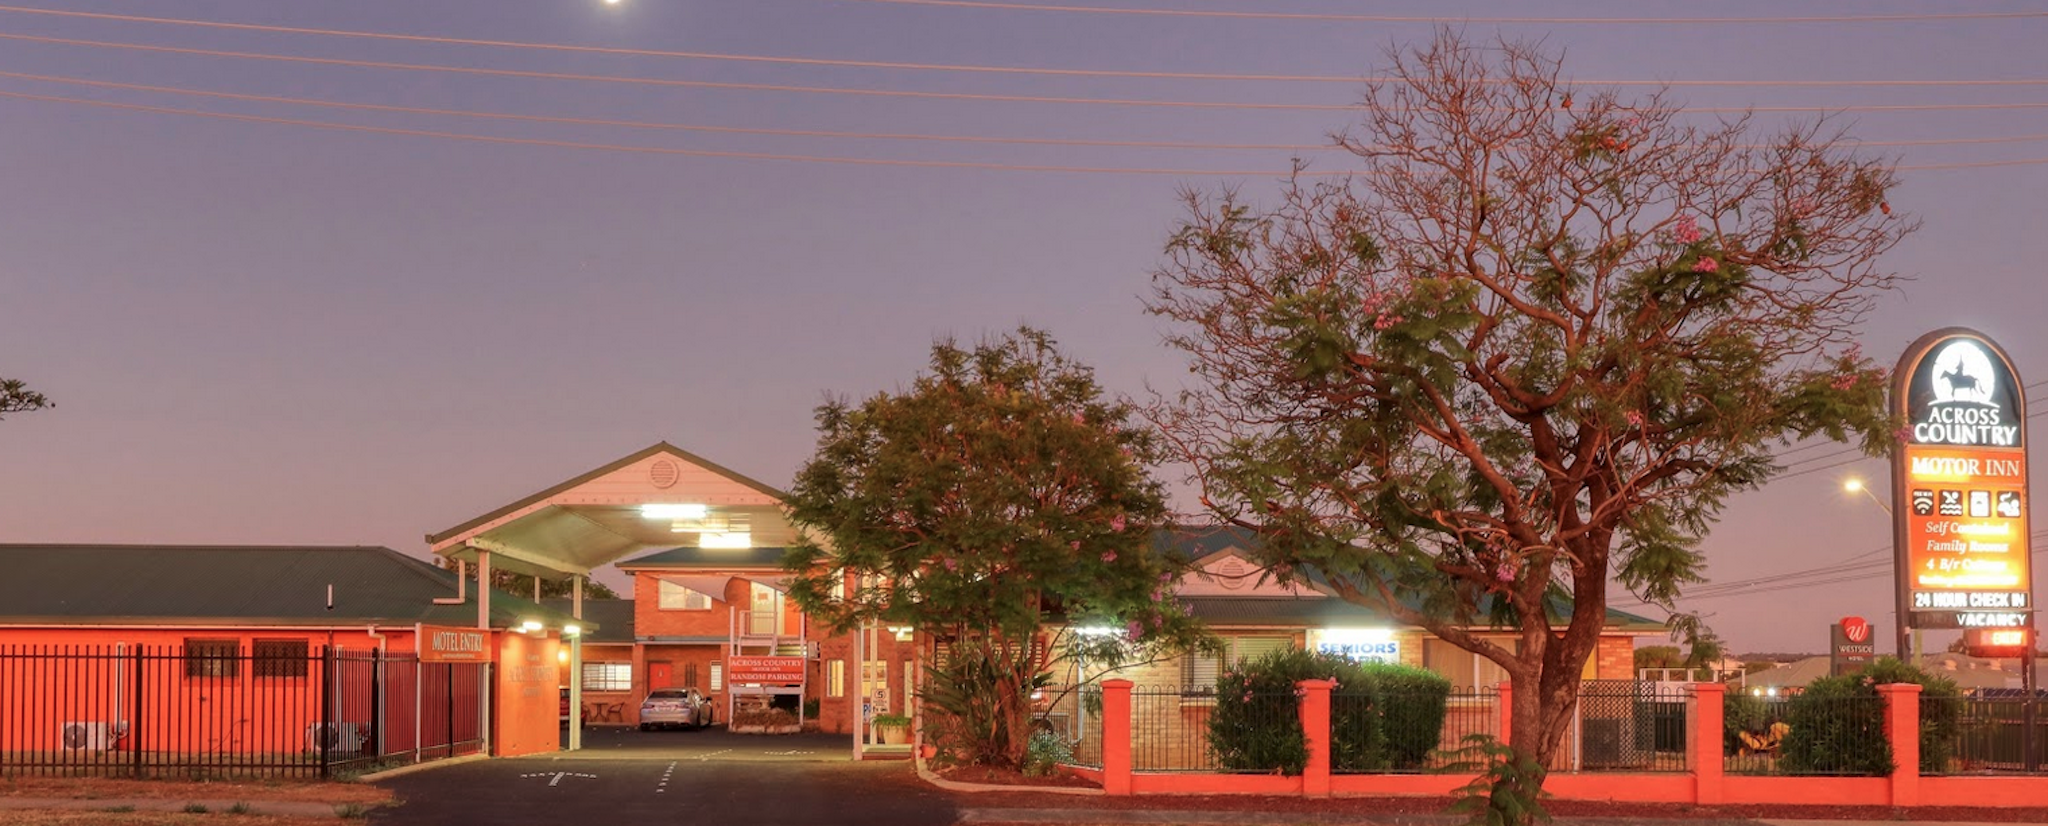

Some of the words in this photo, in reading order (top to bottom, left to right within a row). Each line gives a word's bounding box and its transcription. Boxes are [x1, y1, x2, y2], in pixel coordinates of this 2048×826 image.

[1928, 407, 2000, 425] ACROSS
[1914, 423, 2017, 445] COUNTRY
[1912, 457, 1981, 475] MOTOR
[1985, 460, 2020, 476] INN
[1925, 521, 1949, 536] Self
[1926, 539, 1967, 554] Family
[1926, 558, 1935, 570] 4
[1915, 592, 1931, 607] 24
[1933, 592, 1967, 607] HOUR
[1969, 592, 2009, 607] CHECK
[2011, 592, 2025, 607] IN
[1956, 613, 2027, 626] VACANCY
[432, 631, 459, 651] MOTEL
[460, 632, 484, 651] ENTRY
[1320, 642, 1397, 653] SENIORS
[1838, 645, 1873, 653] WESTSIDE
[877, 690, 884, 699] 5
